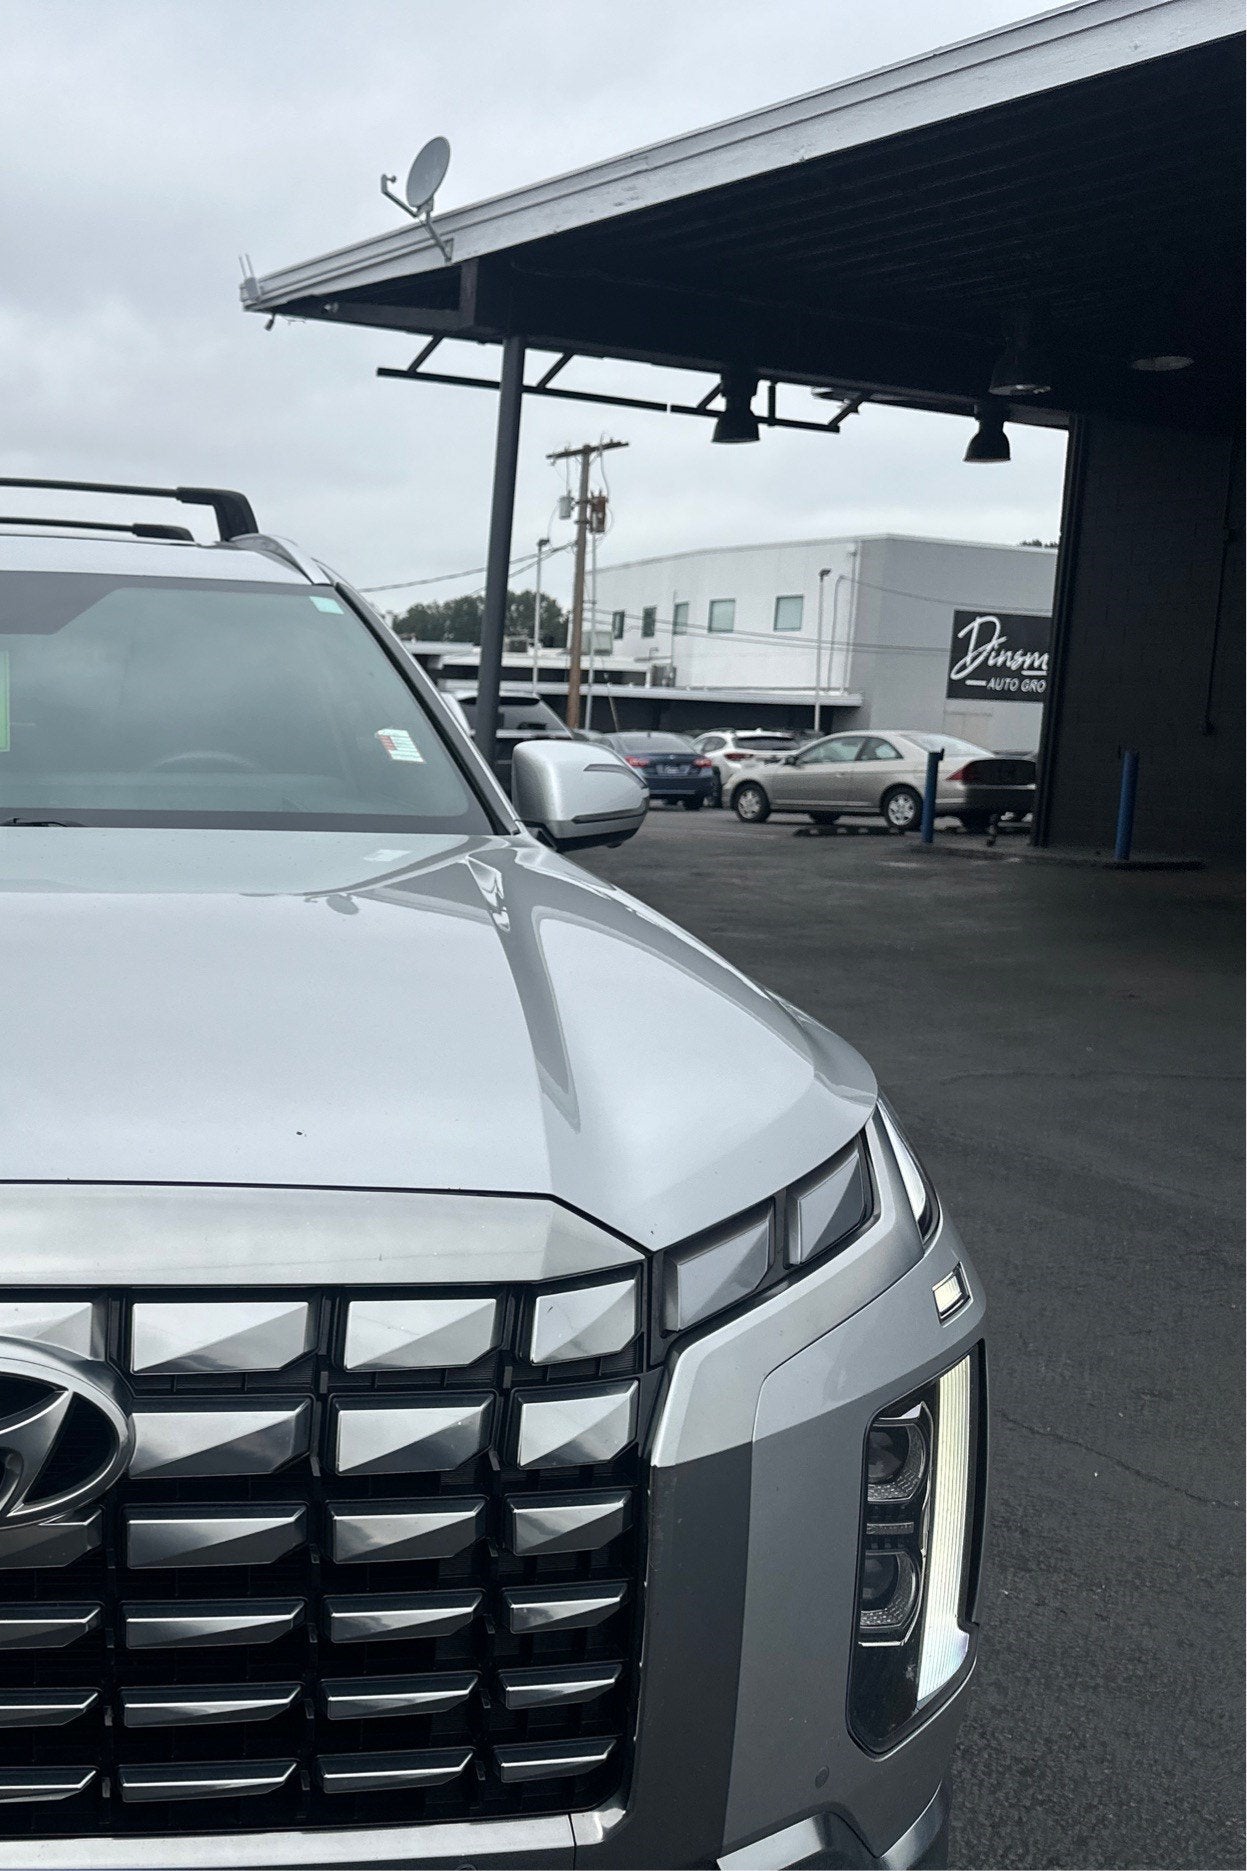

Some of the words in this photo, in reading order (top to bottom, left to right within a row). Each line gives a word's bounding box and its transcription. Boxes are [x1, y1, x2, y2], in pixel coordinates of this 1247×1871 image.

[950, 615, 1049, 680] Dinsm
[986, 678, 1020, 692] AUTO
[1020, 678, 1047, 693] GRO
